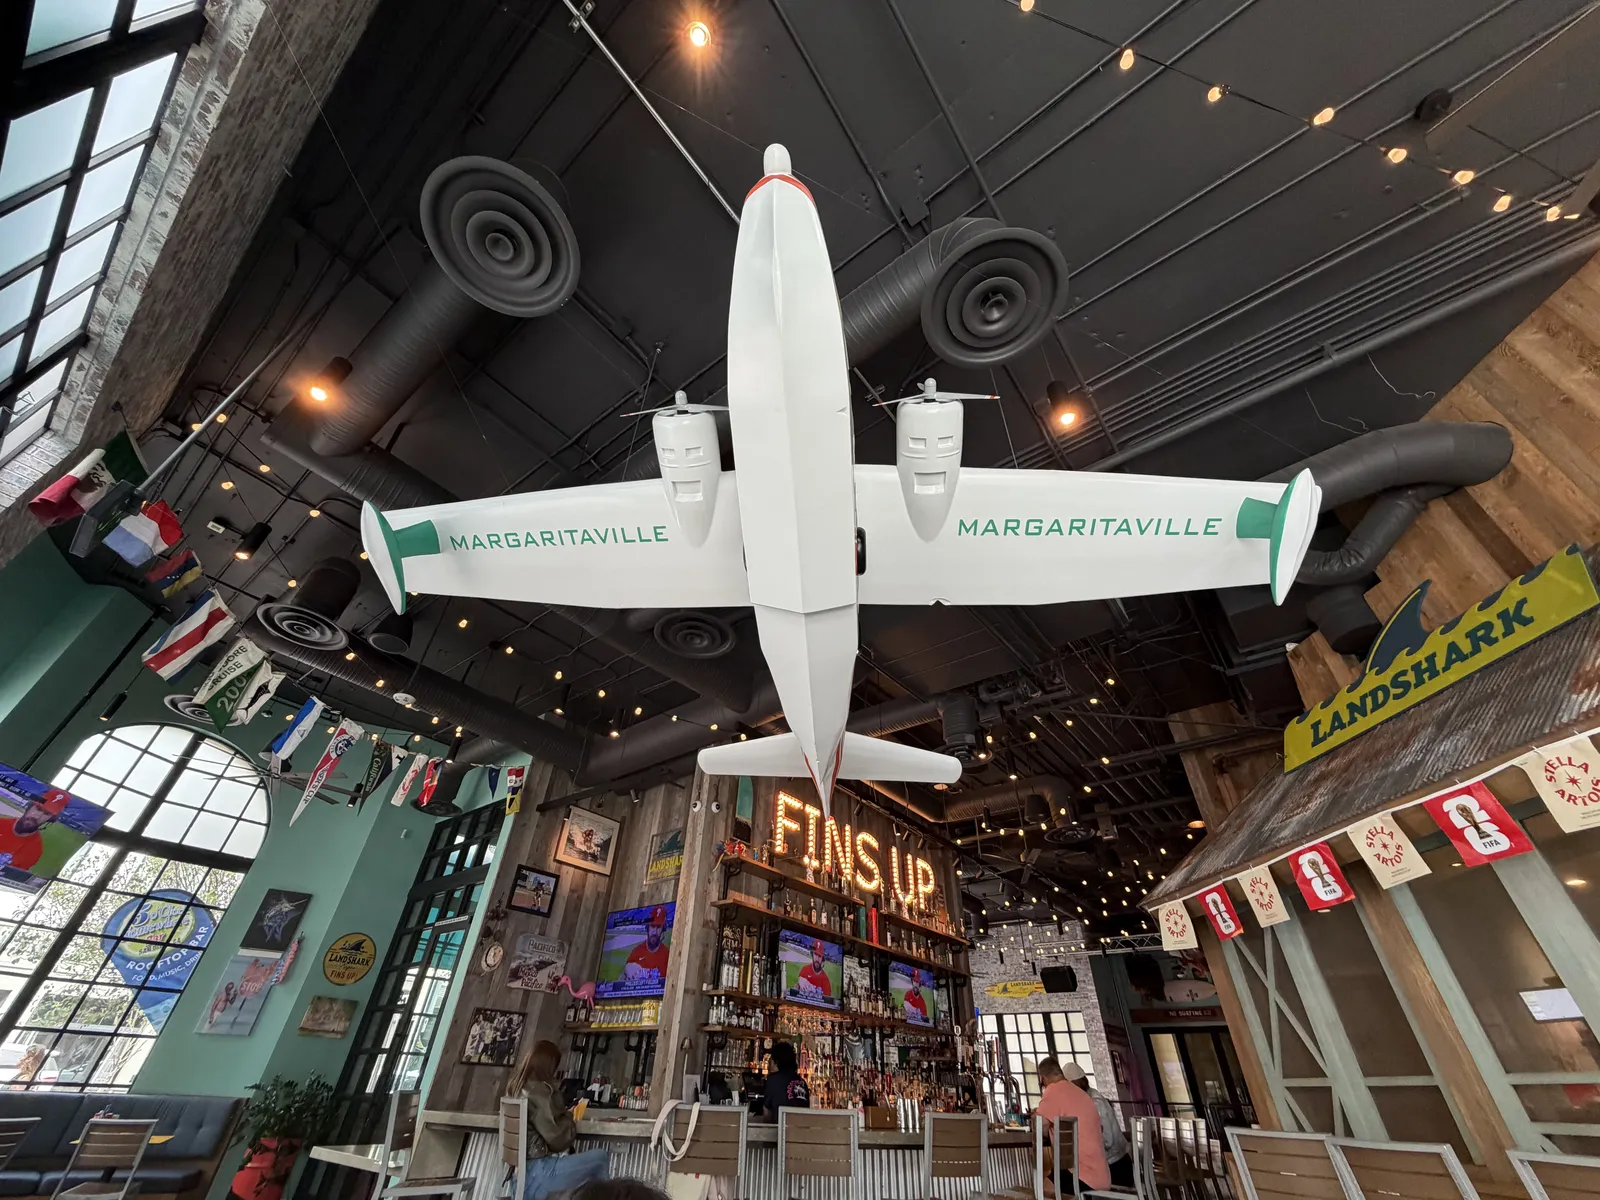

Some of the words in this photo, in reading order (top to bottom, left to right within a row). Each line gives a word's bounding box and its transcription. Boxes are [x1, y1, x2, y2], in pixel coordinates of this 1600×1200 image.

[958, 517, 1222, 537] MARGARITAVILLE
[450, 525, 669, 551] MARGARITAVILLE
[1310, 597, 1535, 749] LANDSHARK
[1544, 756, 1590, 783] STELLA
[1555, 778, 1600, 807] ARTOIS
[1365, 826, 1394, 848] STELLA
[1482, 839, 1501, 849] FIFA
[775, 790, 880, 891] FINS
[891, 845, 935, 909] UP
[1373, 844, 1404, 867] ARTOIS
[1249, 876, 1269, 894] STELLA
[1324, 888, 1337, 896] FIFA
[1255, 893, 1275, 912] ARTOIS
[1165, 908, 1184, 923] STELLA
[189, 926, 210, 947] BAR
[1167, 924, 1187, 938] ARTOIS
[329, 953, 371, 967] LANDSHARK
[158, 966, 187, 981] MUSIC,
[330, 970, 346, 979] FINS
